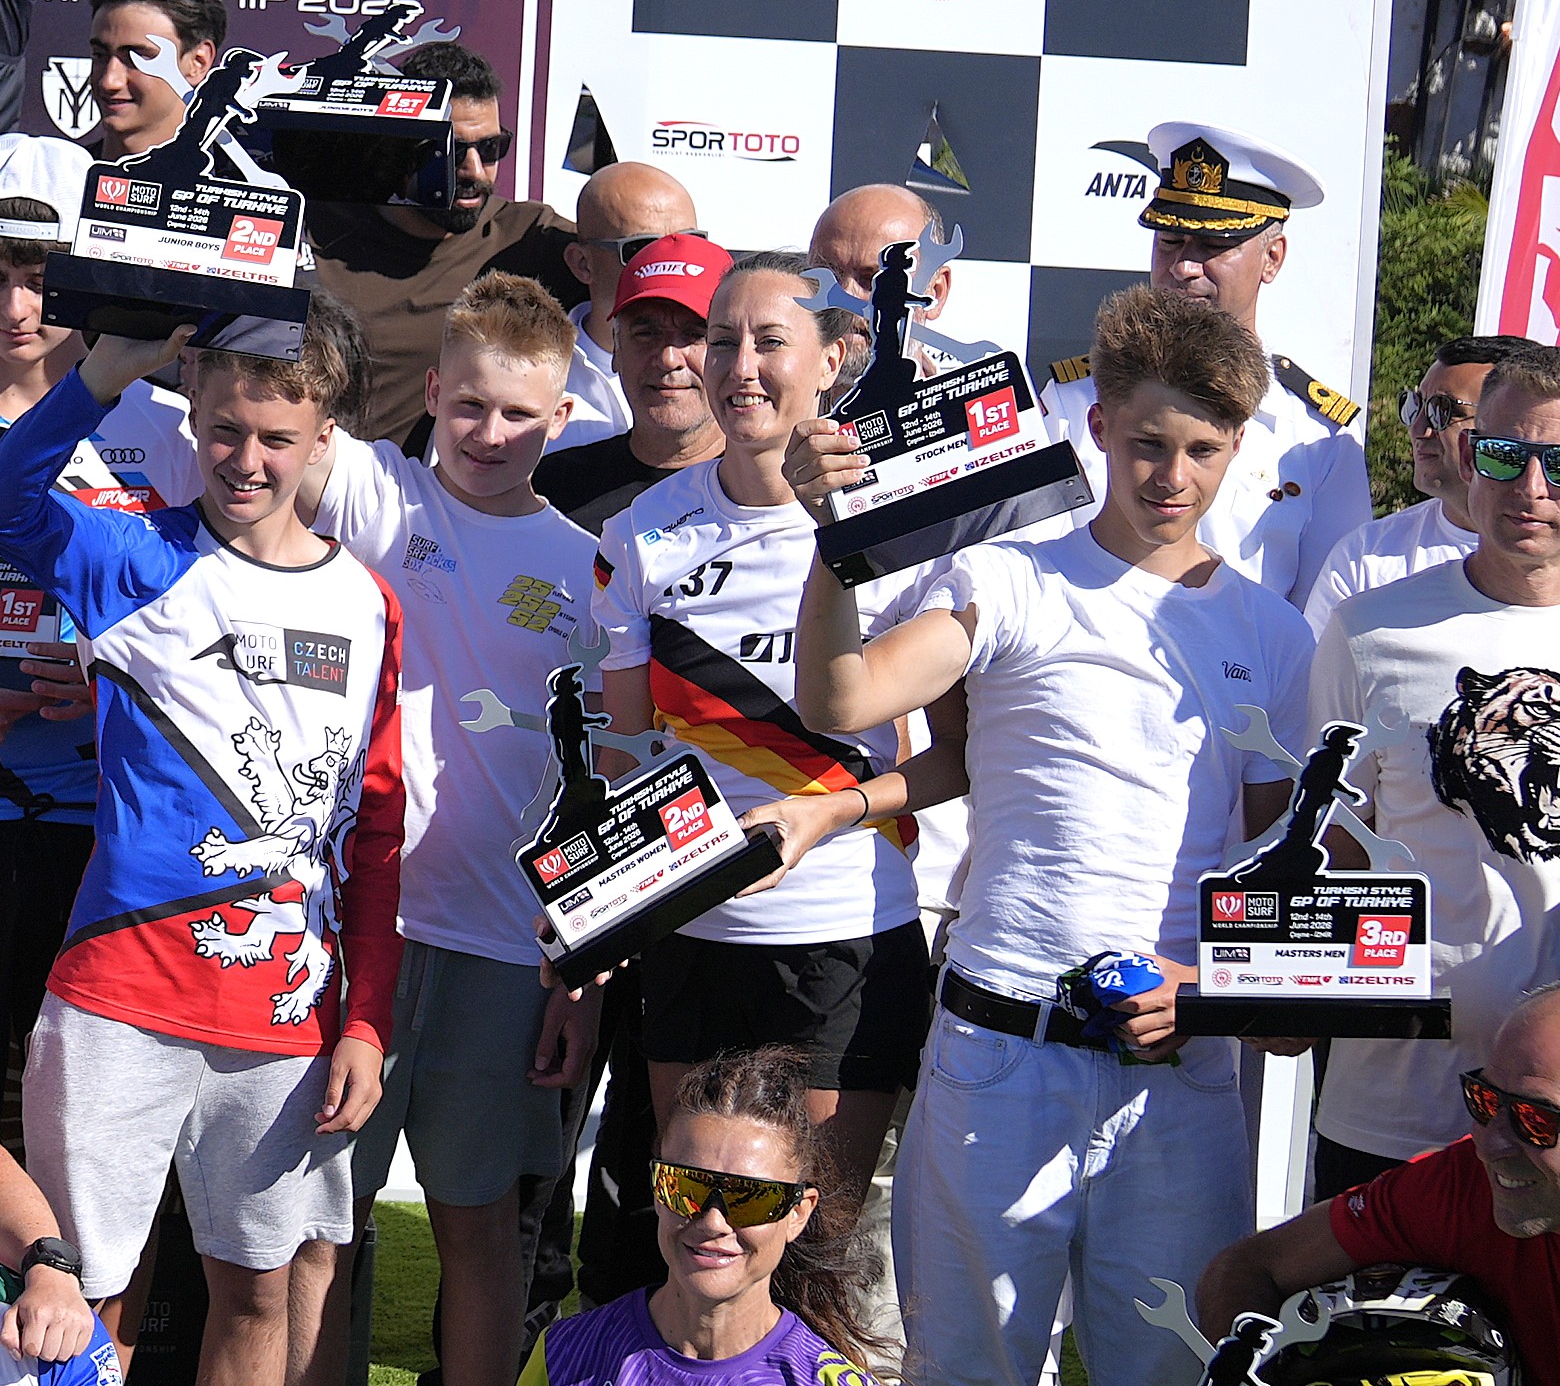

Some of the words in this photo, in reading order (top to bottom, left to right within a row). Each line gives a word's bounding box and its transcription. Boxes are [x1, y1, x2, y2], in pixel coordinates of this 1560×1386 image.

[651, 128, 801, 155] SPORTOTO
[1085, 172, 1149, 200] ANTA
[157, 236, 194, 248] JUNIOR
[194, 240, 222, 252] BOYS
[230, 219, 277, 246] 2ND
[232, 244, 266, 256] PLACE
[968, 399, 1011, 428] 1ST
[978, 420, 1011, 439] PLACE
[914, 445, 946, 463] STOCK
[947, 439, 968, 454] MEN
[508, 575, 555, 599] 25
[1, 592, 37, 616] 1ST
[497, 589, 562, 619] 252
[2, 616, 30, 626] PLACE
[506, 607, 551, 634] 52
[235, 631, 279, 652] MOTO
[293, 640, 347, 666] CZECH
[293, 659, 347, 686] TALENT
[1221, 661, 1253, 683] Vans
[665, 801, 706, 833] 2ND
[677, 819, 705, 842] PLACE
[598, 859, 637, 888] MASTERS
[636, 841, 668, 867] WOMEN
[1358, 920, 1408, 947] 3RD
[1275, 949, 1323, 959] MASTERS
[1324, 949, 1347, 959] MEN
[1363, 948, 1398, 959] PLACE
